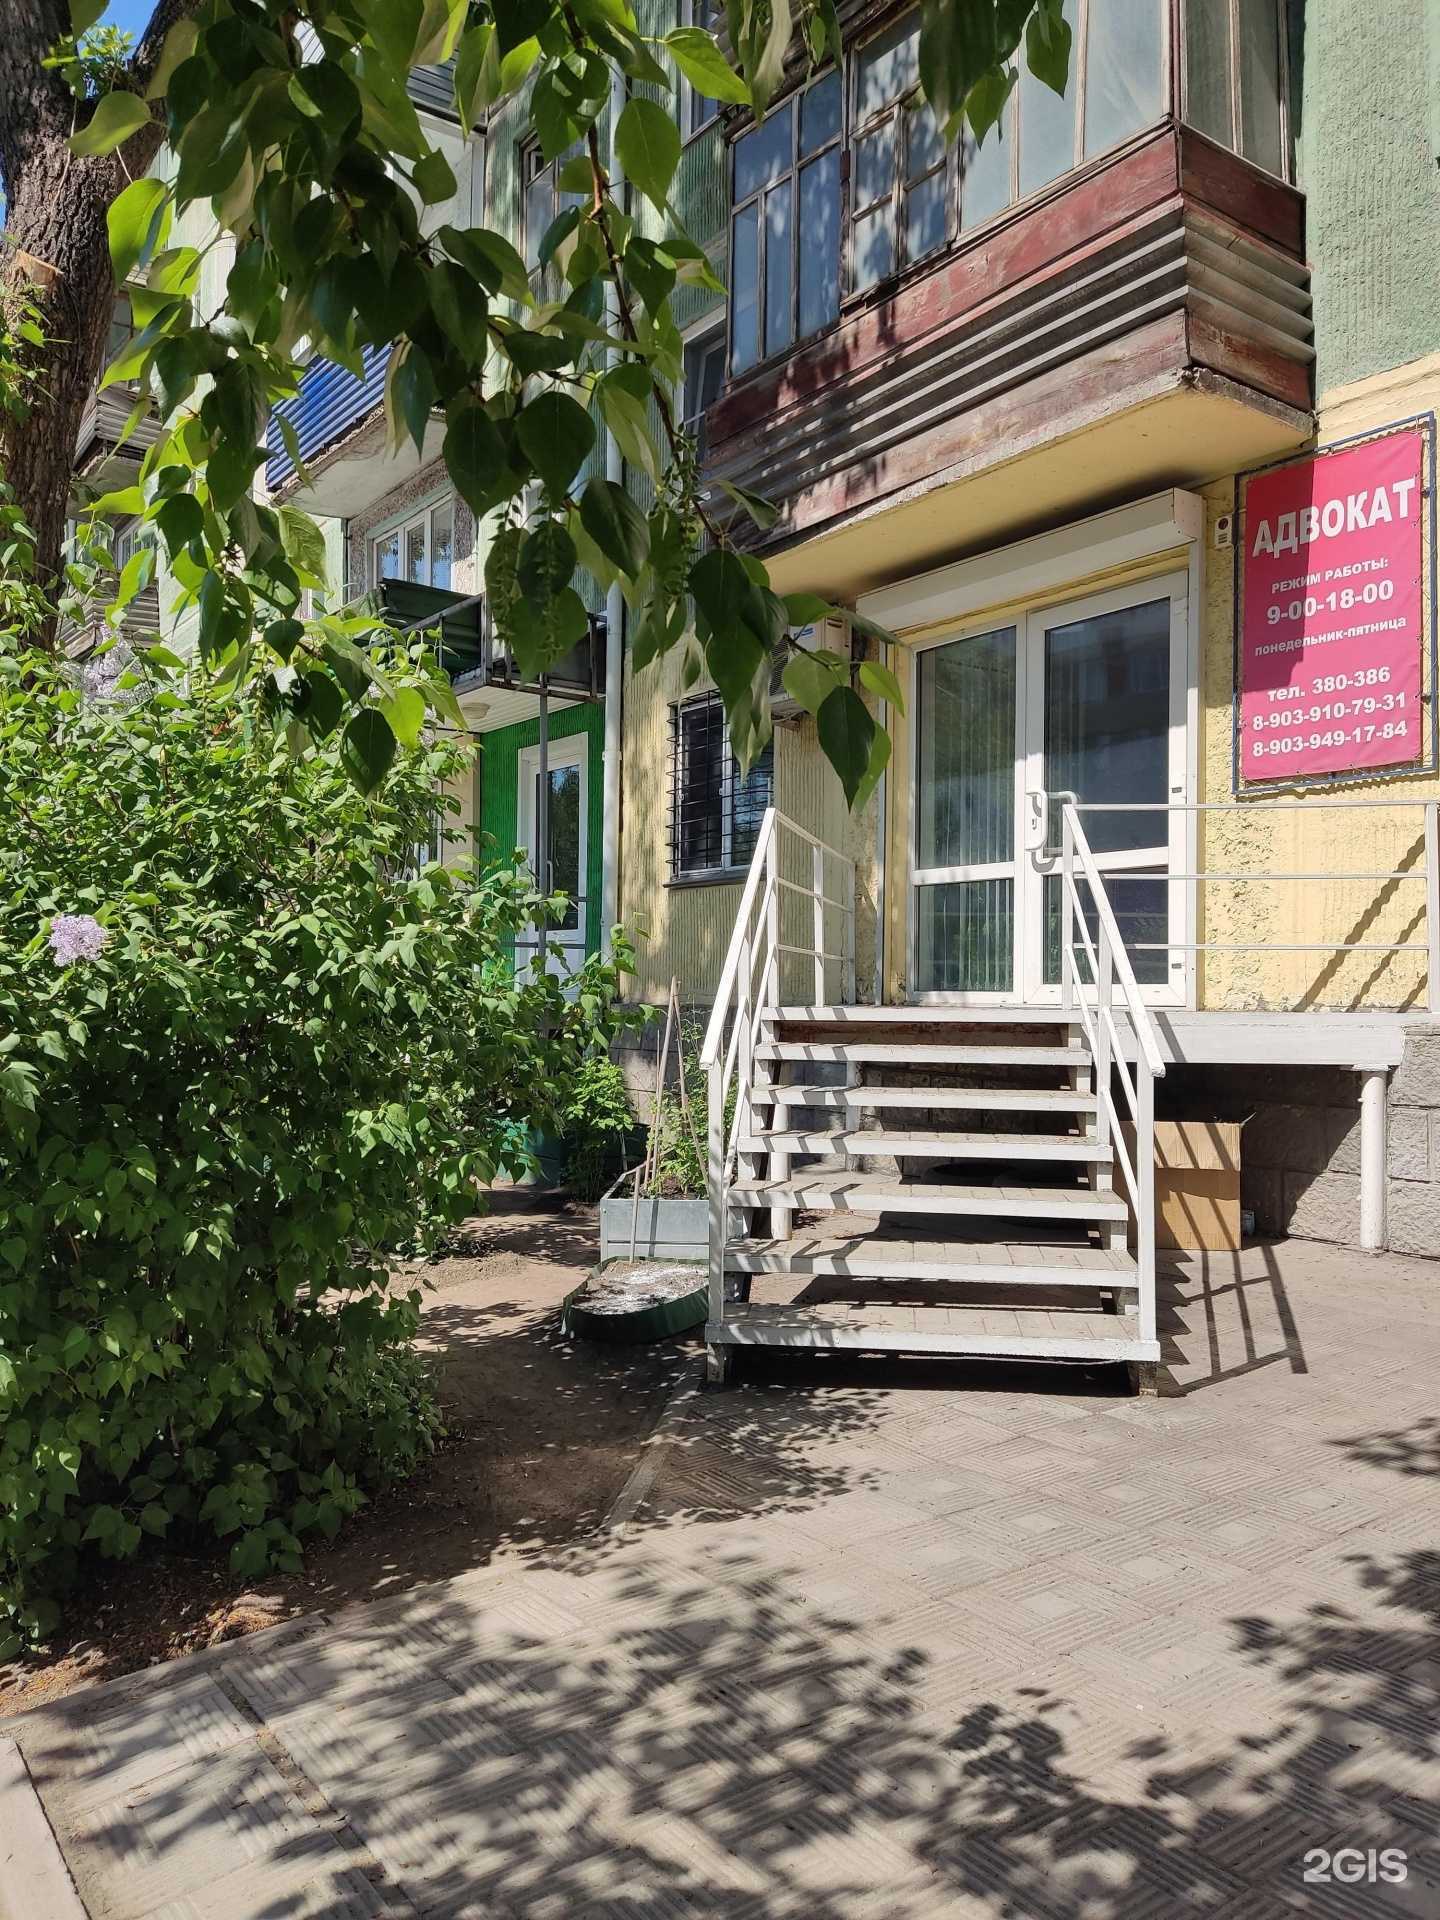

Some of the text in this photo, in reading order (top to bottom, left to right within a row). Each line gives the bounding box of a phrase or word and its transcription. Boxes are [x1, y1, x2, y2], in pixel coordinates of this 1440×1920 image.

[1252, 478, 1416, 559] АДВОКАТ
[1271, 557, 1389, 594] РЕЖИМ РАБОТЫ:
[1267, 579, 1394, 625] 9-00-18-00
[1255, 616, 1407, 656] понедельник-пятница
[1267, 666, 1391, 703] тел. 380-386
[1252, 692, 1406, 731] 8-903-910-79-31
[1252, 720, 1408, 758] 8-903-949-17-84
